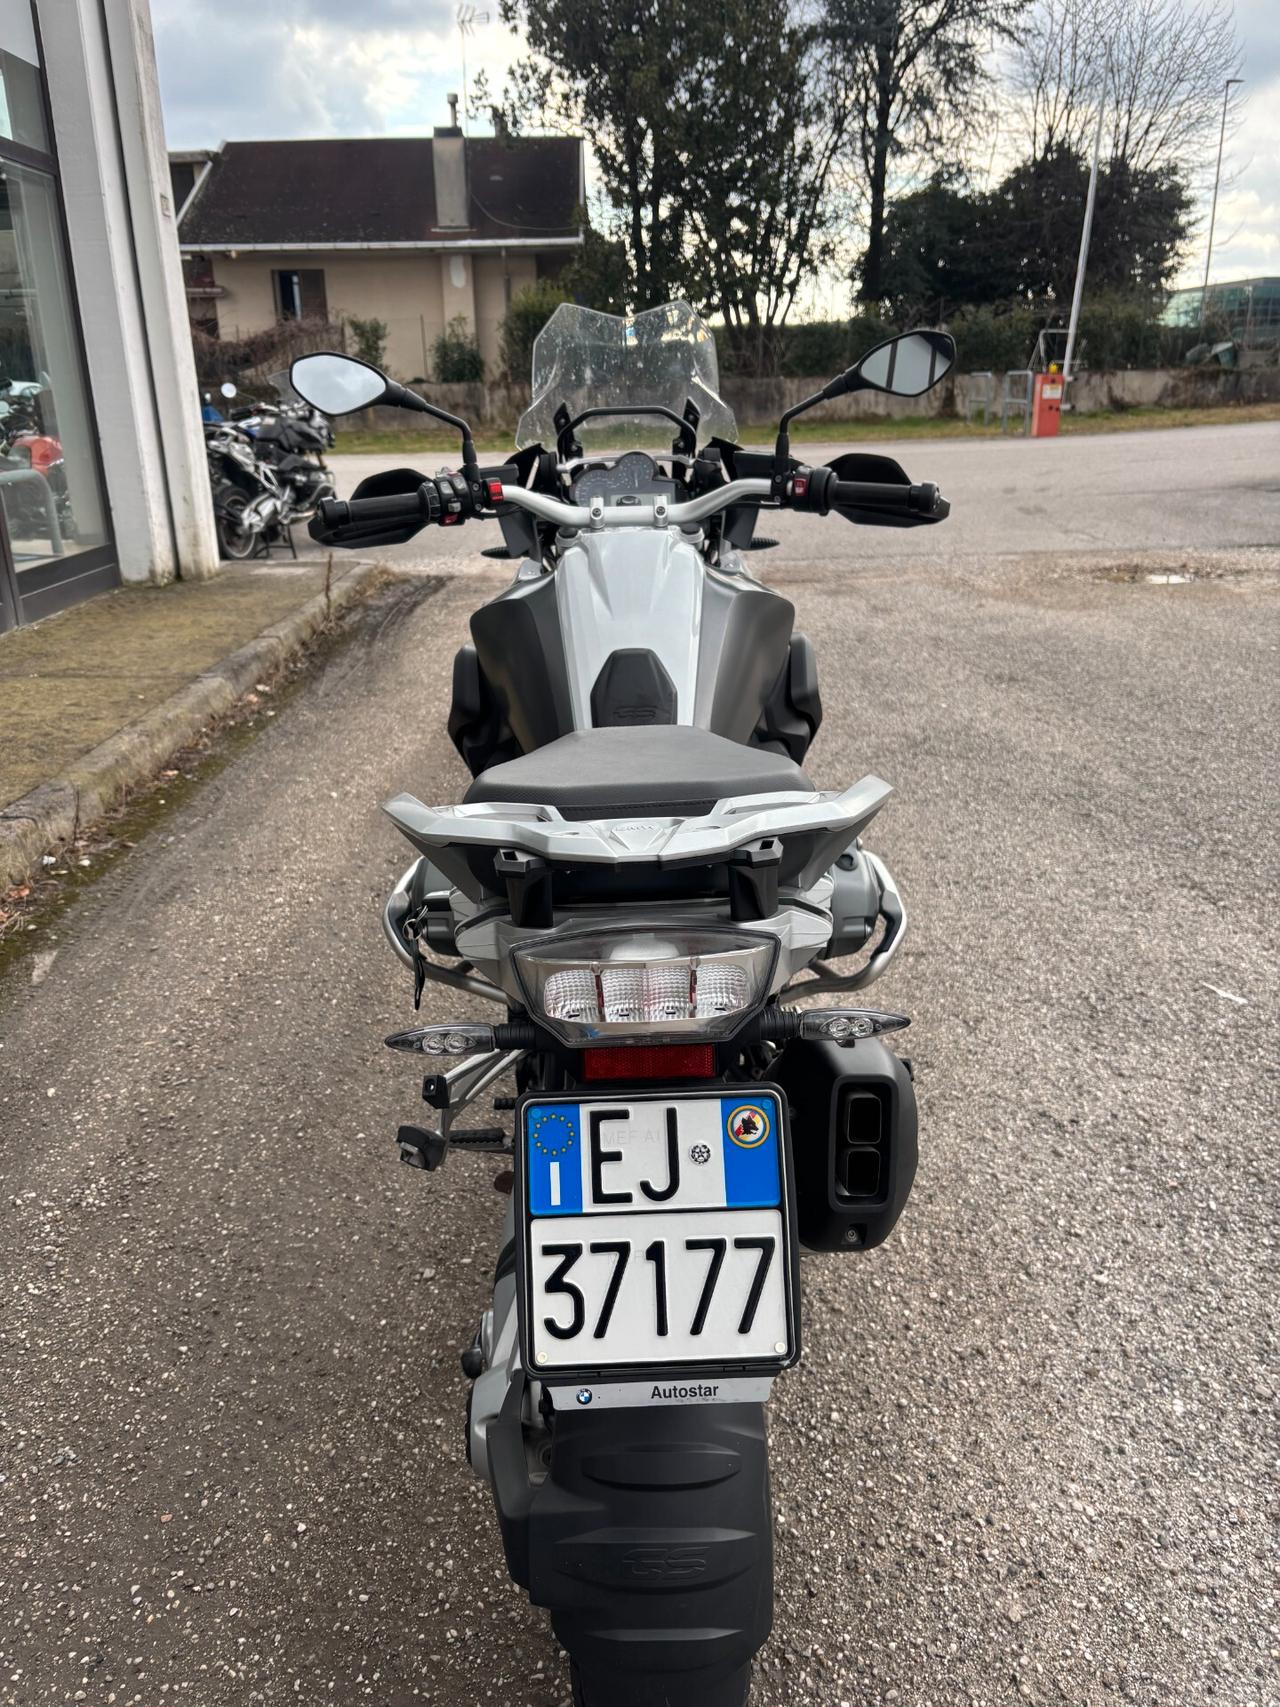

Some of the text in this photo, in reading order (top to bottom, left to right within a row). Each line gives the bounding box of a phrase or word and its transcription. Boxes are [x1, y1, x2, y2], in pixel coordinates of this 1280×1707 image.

[590, 1107, 680, 1204] EJ
[541, 1236, 776, 1340] 37177
[651, 1384, 719, 1399] Autostar
